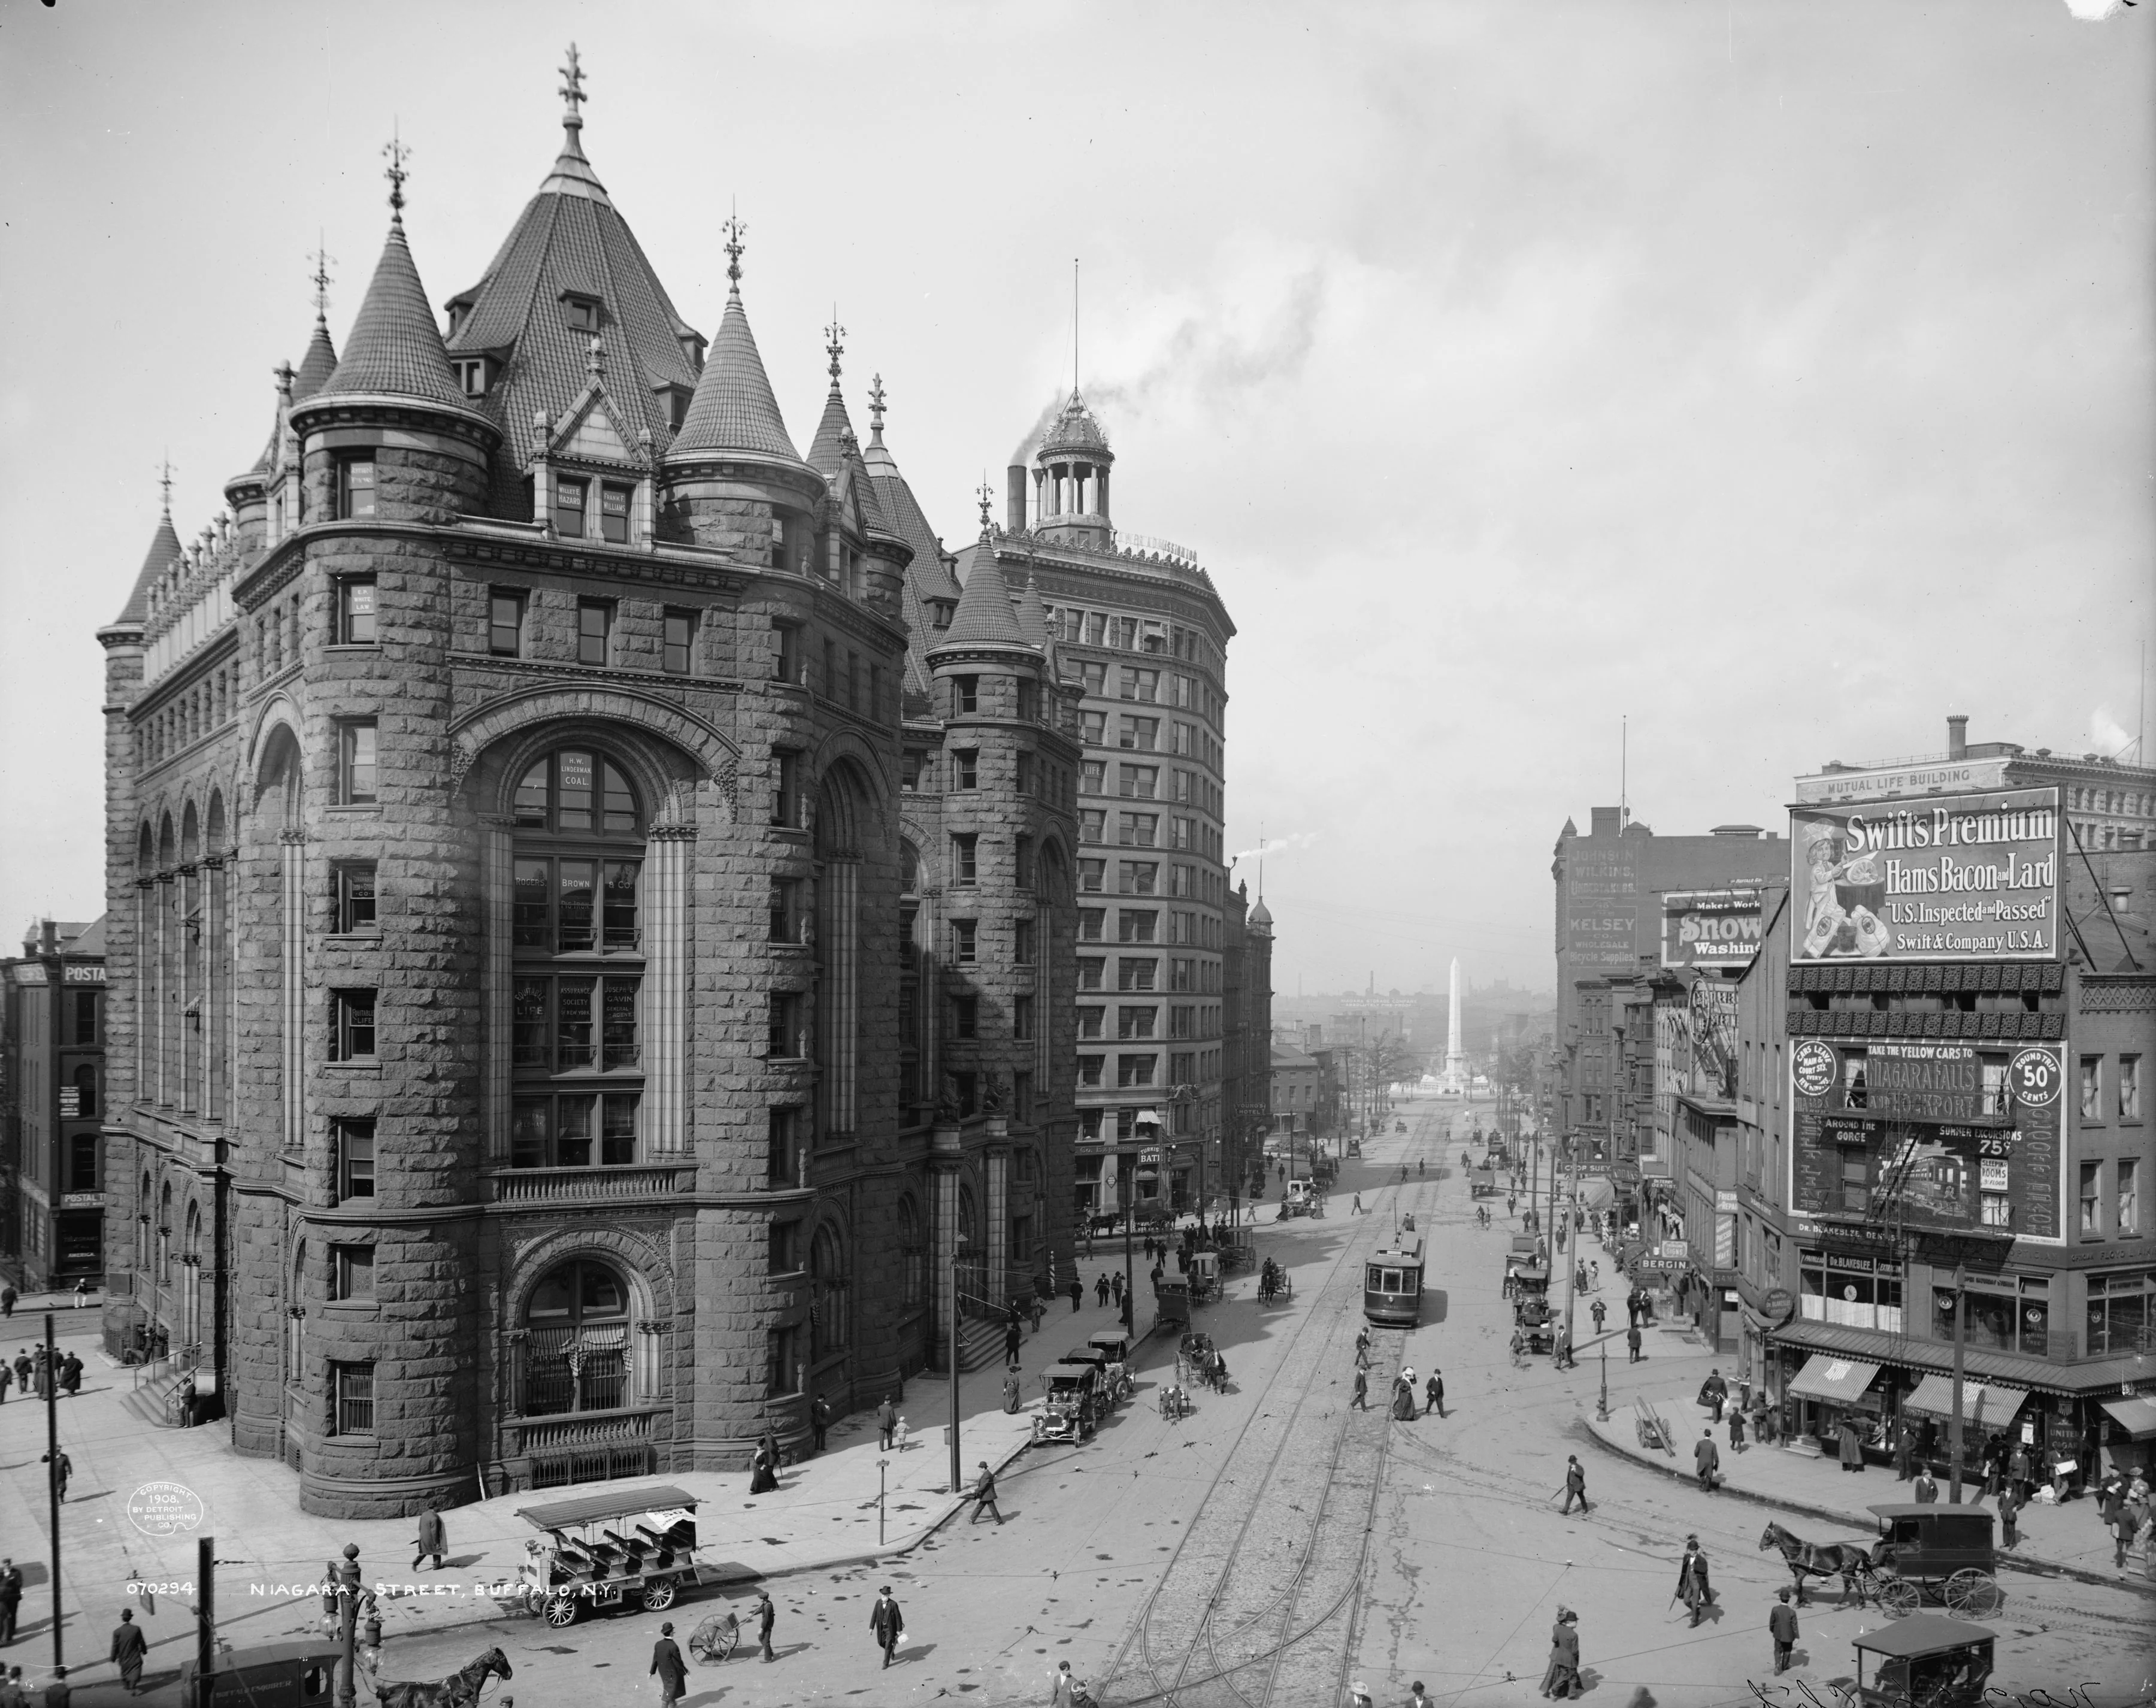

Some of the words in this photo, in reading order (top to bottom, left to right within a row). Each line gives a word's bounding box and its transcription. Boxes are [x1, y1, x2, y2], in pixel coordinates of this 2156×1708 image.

[604, 493, 620, 501] FRANK
[603, 501, 626, 512] WILLIAMS
[565, 777, 589, 786] COAL.
[1828, 780, 1873, 794] MUTUAL
[1878, 778, 1903, 789] LIFE
[1910, 769, 1970, 786] BUILDING
[1846, 810, 1930, 853] Swift's
[1931, 802, 2054, 847] Premium
[1885, 858, 1939, 895] Hams
[1939, 856, 1998, 892] Bacon
[1997, 867, 2009, 882] and
[2007, 850, 2054, 890] Lard
[562, 878, 590, 888] BROWN
[618, 881, 632, 889] CO.
[1918, 901, 1983, 926] Inspected
[1982, 904, 1995, 916] and
[1570, 918, 1635, 931] KELSEY
[1679, 911, 1762, 947] Snow
[1897, 932, 1932, 950] Swift
[1933, 933, 1943, 950] &
[1945, 932, 2005, 953] Company
[2006, 929, 2049, 950] U.S.A.
[1570, 951, 1598, 965] Bicycle
[514, 987, 546, 1001] EQUITABLE
[517, 1007, 544, 1015] LIFE
[1797, 1046, 1812, 1062] CARS
[1813, 1045, 1832, 1063] LEAVE
[1868, 1045, 1885, 1055] TAKE
[1886, 1046, 1899, 1056] THE
[1900, 1046, 1935, 1059] YELLOW
[1936, 1048, 1961, 1059] CARS
[1963, 1048, 1973, 1058] TO
[1803, 1057, 1817, 1066] MAIN
[2015, 1052, 2041, 1070] ROUND
[2042, 1055, 2057, 1073] TRIP
[1798, 1066, 1816, 1074] COURT
[1868, 1058, 1932, 1090] NIAGARA
[1934, 1060, 1975, 1091] FALLS
[2023, 1065, 2048, 1088] 50
[1798, 1077, 1809, 1089] FEW
[2022, 1091, 2048, 1102] CENTS
[1887, 1093, 1973, 1118] LOCKPORT
[1825, 1119, 1859, 1129] AROUND
[1861, 1121, 1876, 1131] THE
[1836, 1131, 1866, 1143] GORGE
[1939, 1125, 1972, 1137] SUMMER
[1975, 1128, 2022, 1141] EXCURSIONS
[1096, 1144, 1134, 1153] Express.
[1982, 1168, 2006, 1179] ROOMS
[65, 1194, 98, 1203] POSTAL
[1798, 1224, 1811, 1232] DR.
[2100, 1249, 2125, 1260] FLOYD
[1643, 1259, 1689, 1269] BERGIN.
[1807, 1394, 1822, 1403] CIGAR
[1822, 1397, 1840, 1406] STORES
[1906, 1407, 1930, 1418] UNITED
[2050, 1429, 2079, 1437] UNITED
